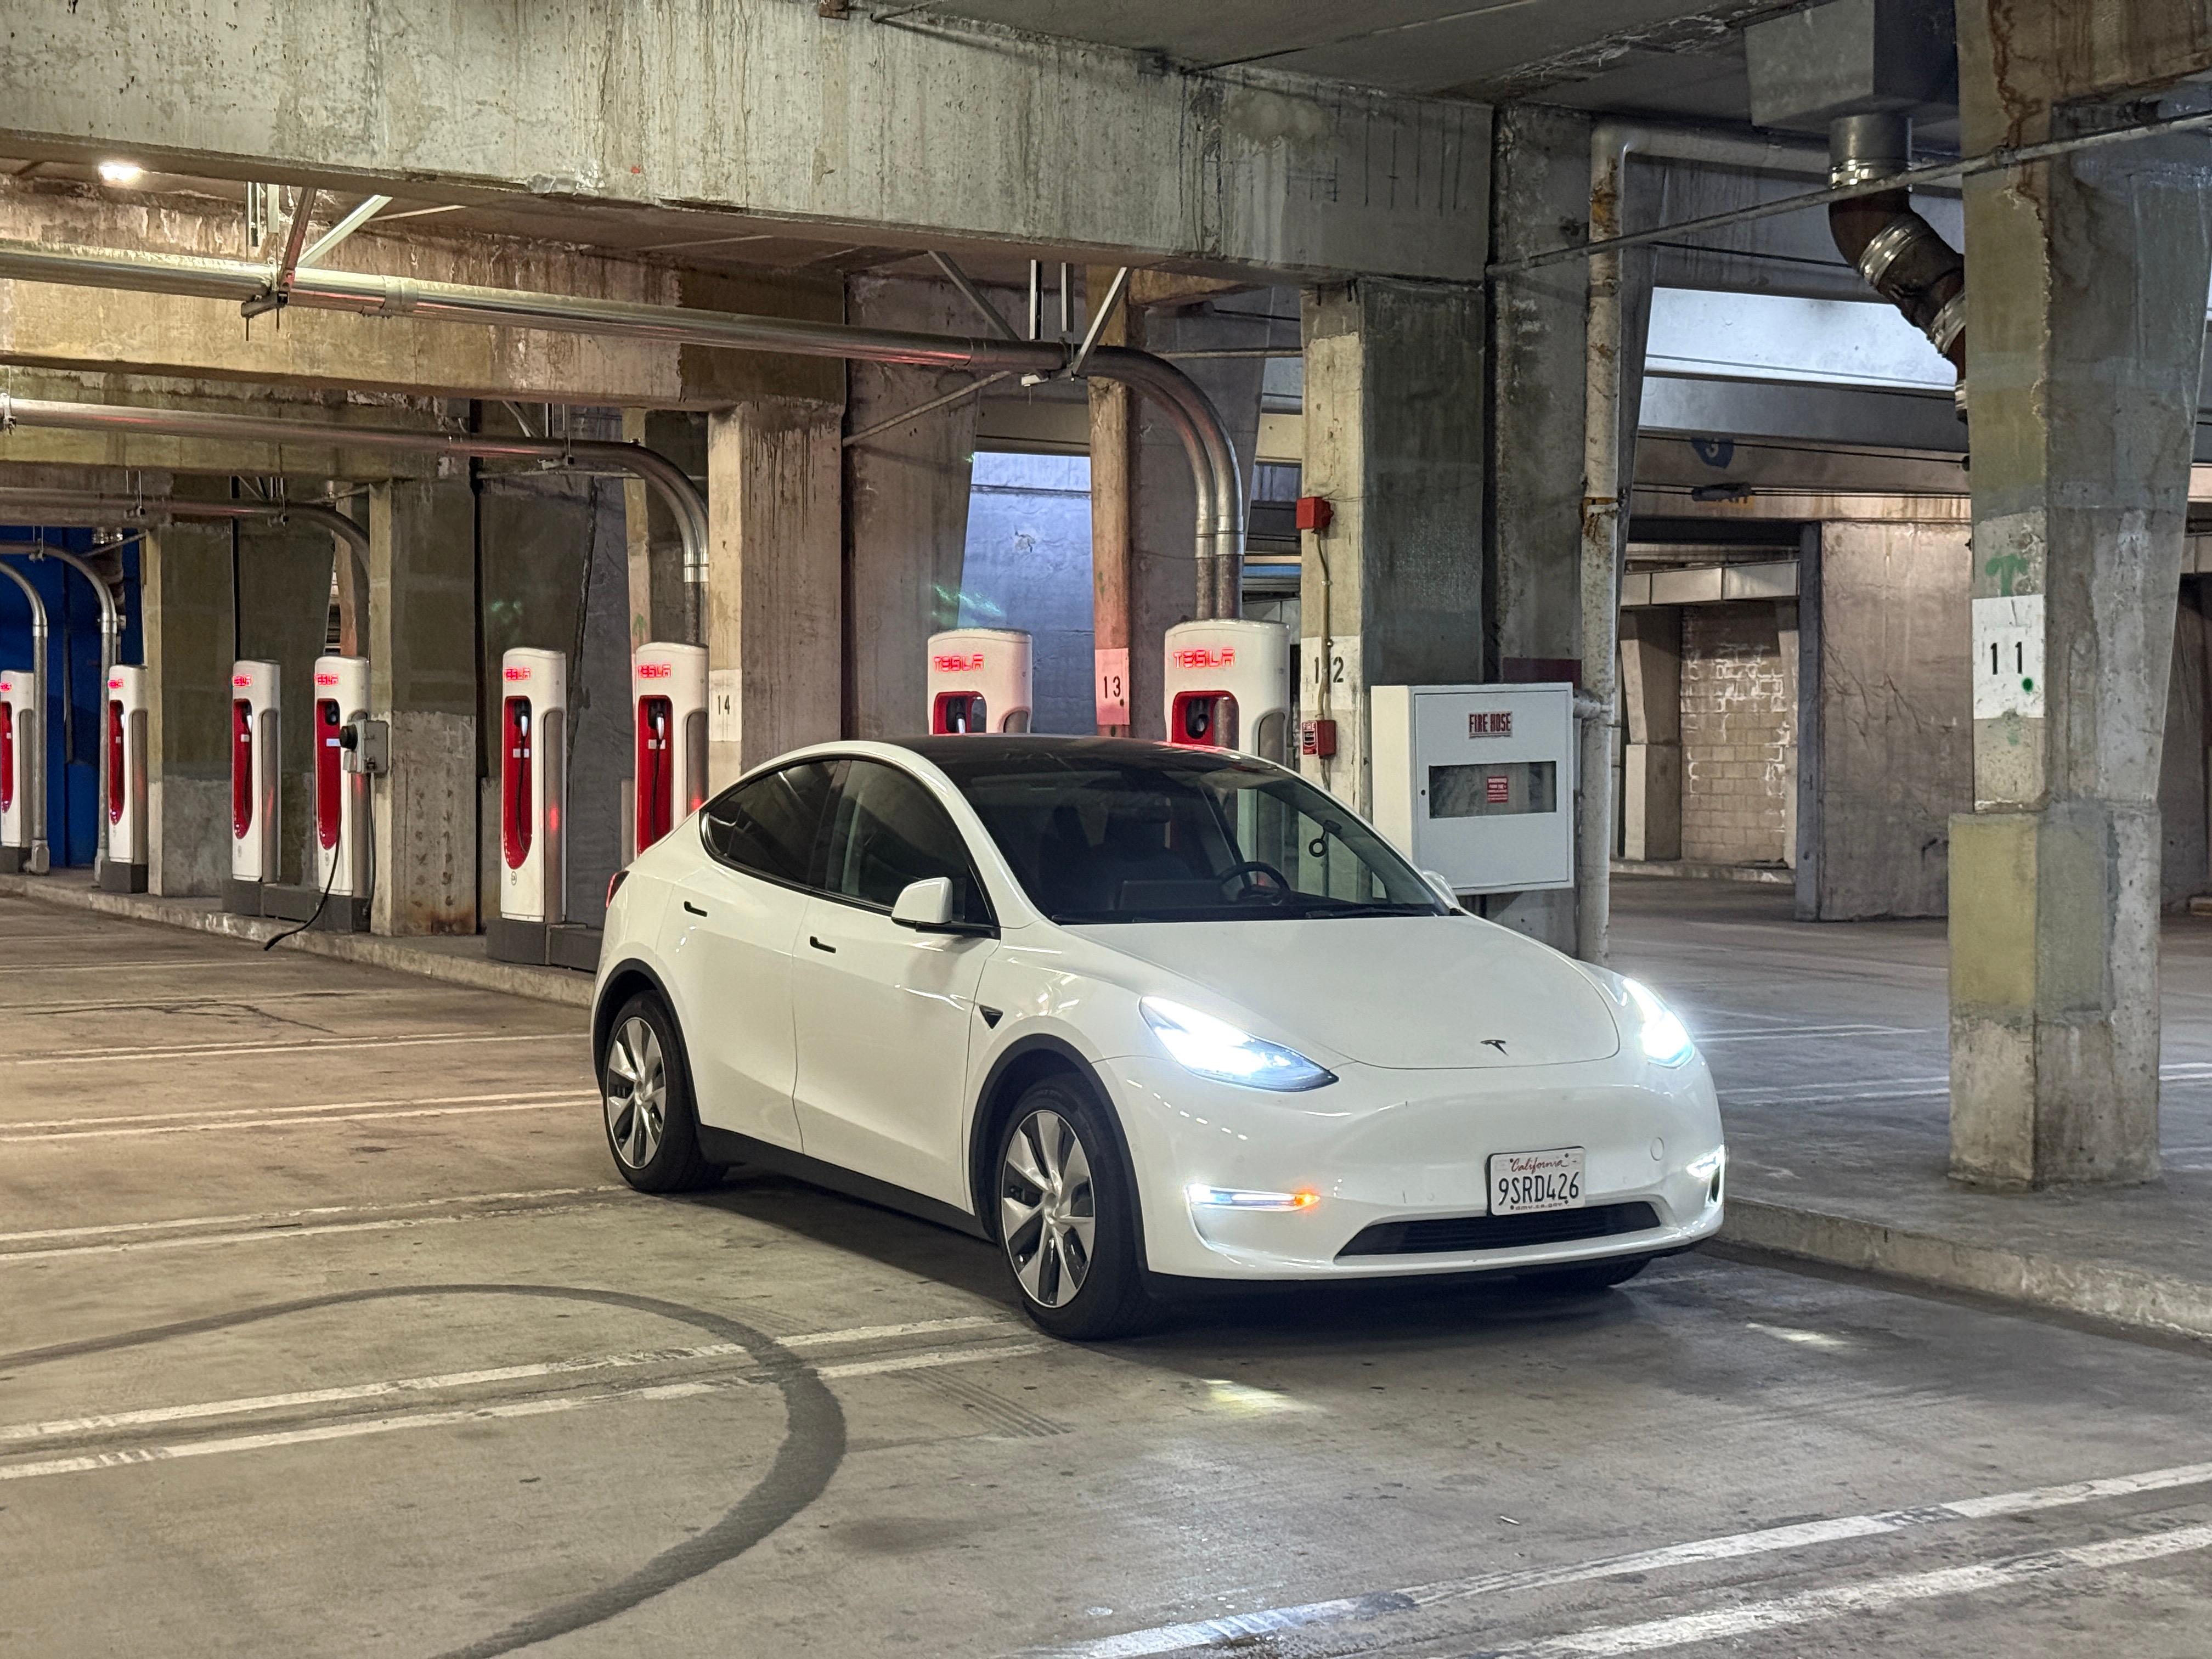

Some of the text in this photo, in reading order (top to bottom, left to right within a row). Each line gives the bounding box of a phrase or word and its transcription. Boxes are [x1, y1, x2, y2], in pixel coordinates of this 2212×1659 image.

[934, 653, 984, 672] TESLA
[1173, 648, 1235, 669] TESLA
[1990, 641, 2022, 675] 11
[315, 673, 339, 686] ESLA
[637, 664, 672, 679] TESLA
[1104, 675, 1121, 698] 13
[718, 695, 730, 715] 14
[1469, 713, 1511, 732] FIRE HOSE
[1511, 1157, 1569, 1175] California
[1498, 1172, 1579, 1206] 9SRD426
